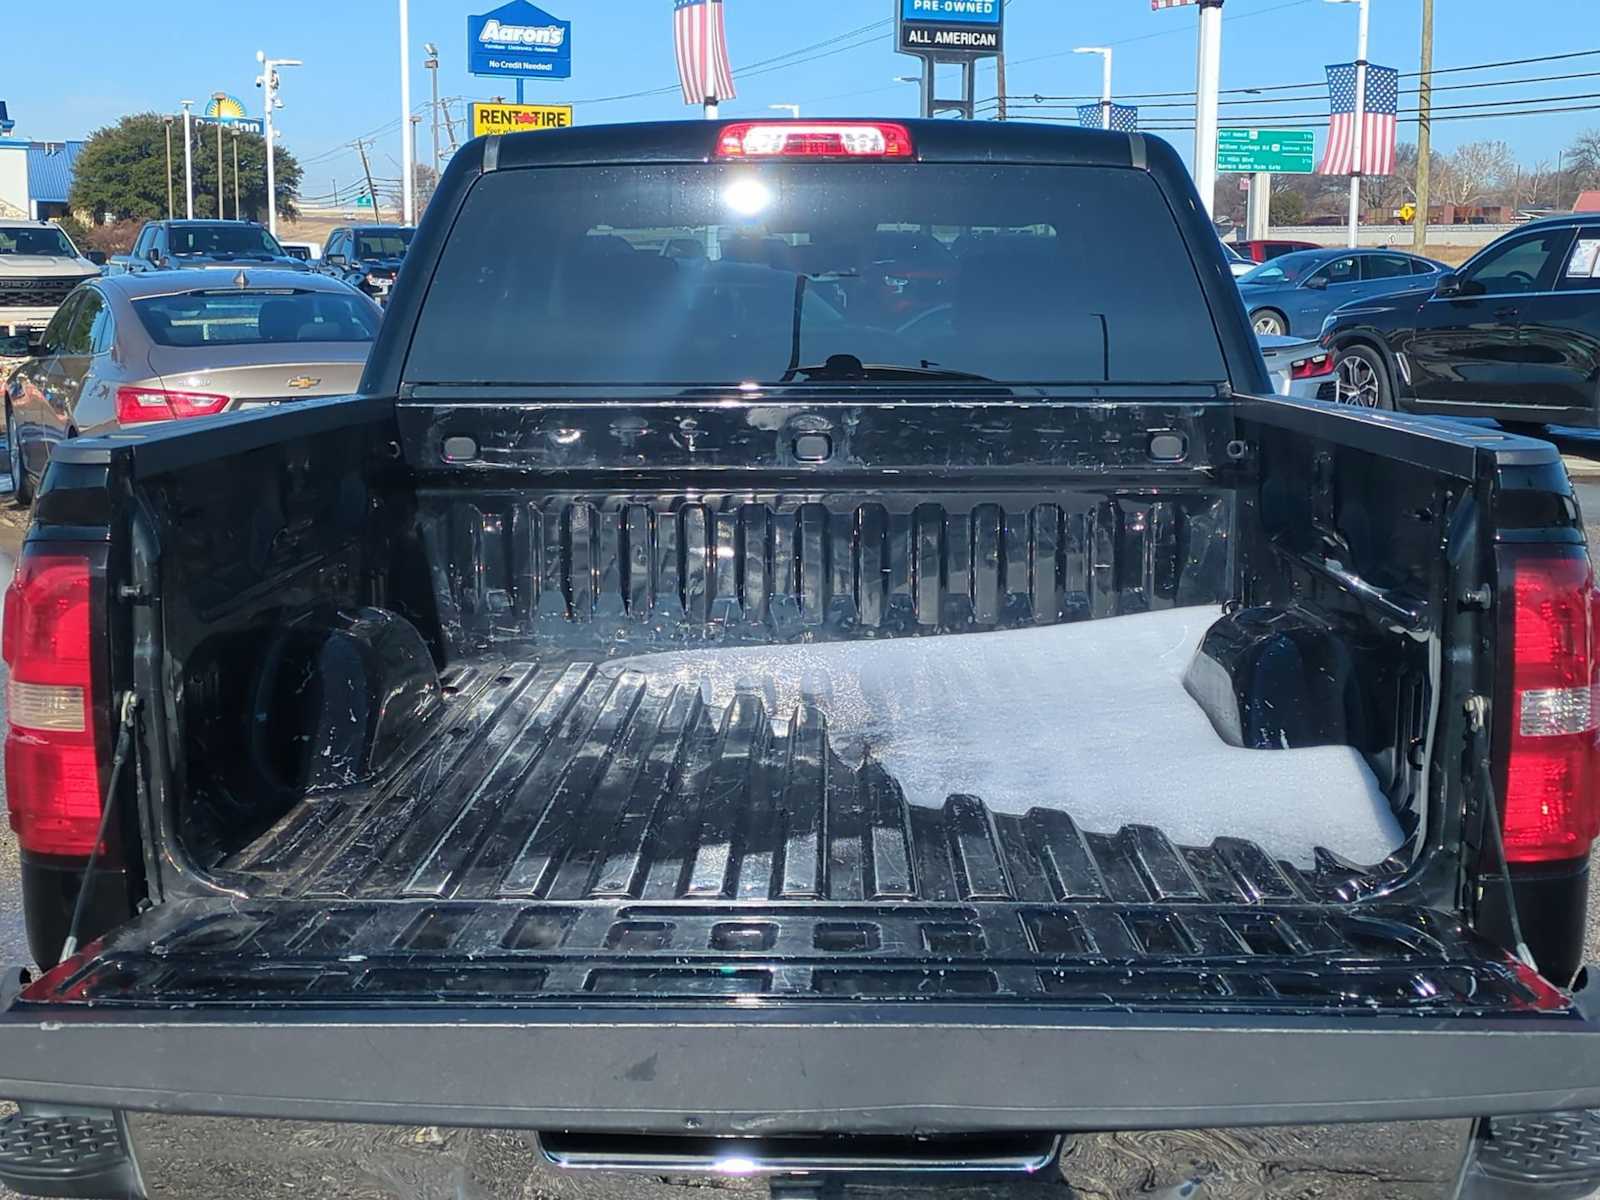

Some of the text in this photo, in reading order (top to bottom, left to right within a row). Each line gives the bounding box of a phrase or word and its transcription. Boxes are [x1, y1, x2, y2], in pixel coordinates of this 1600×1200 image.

[913, 0, 993, 14] PRE-OWNED
[479, 19, 565, 46] Aaron's
[909, 30, 996, 46] ALL AMERICAN
[489, 60, 500, 68] No
[500, 60, 523, 70] Credit
